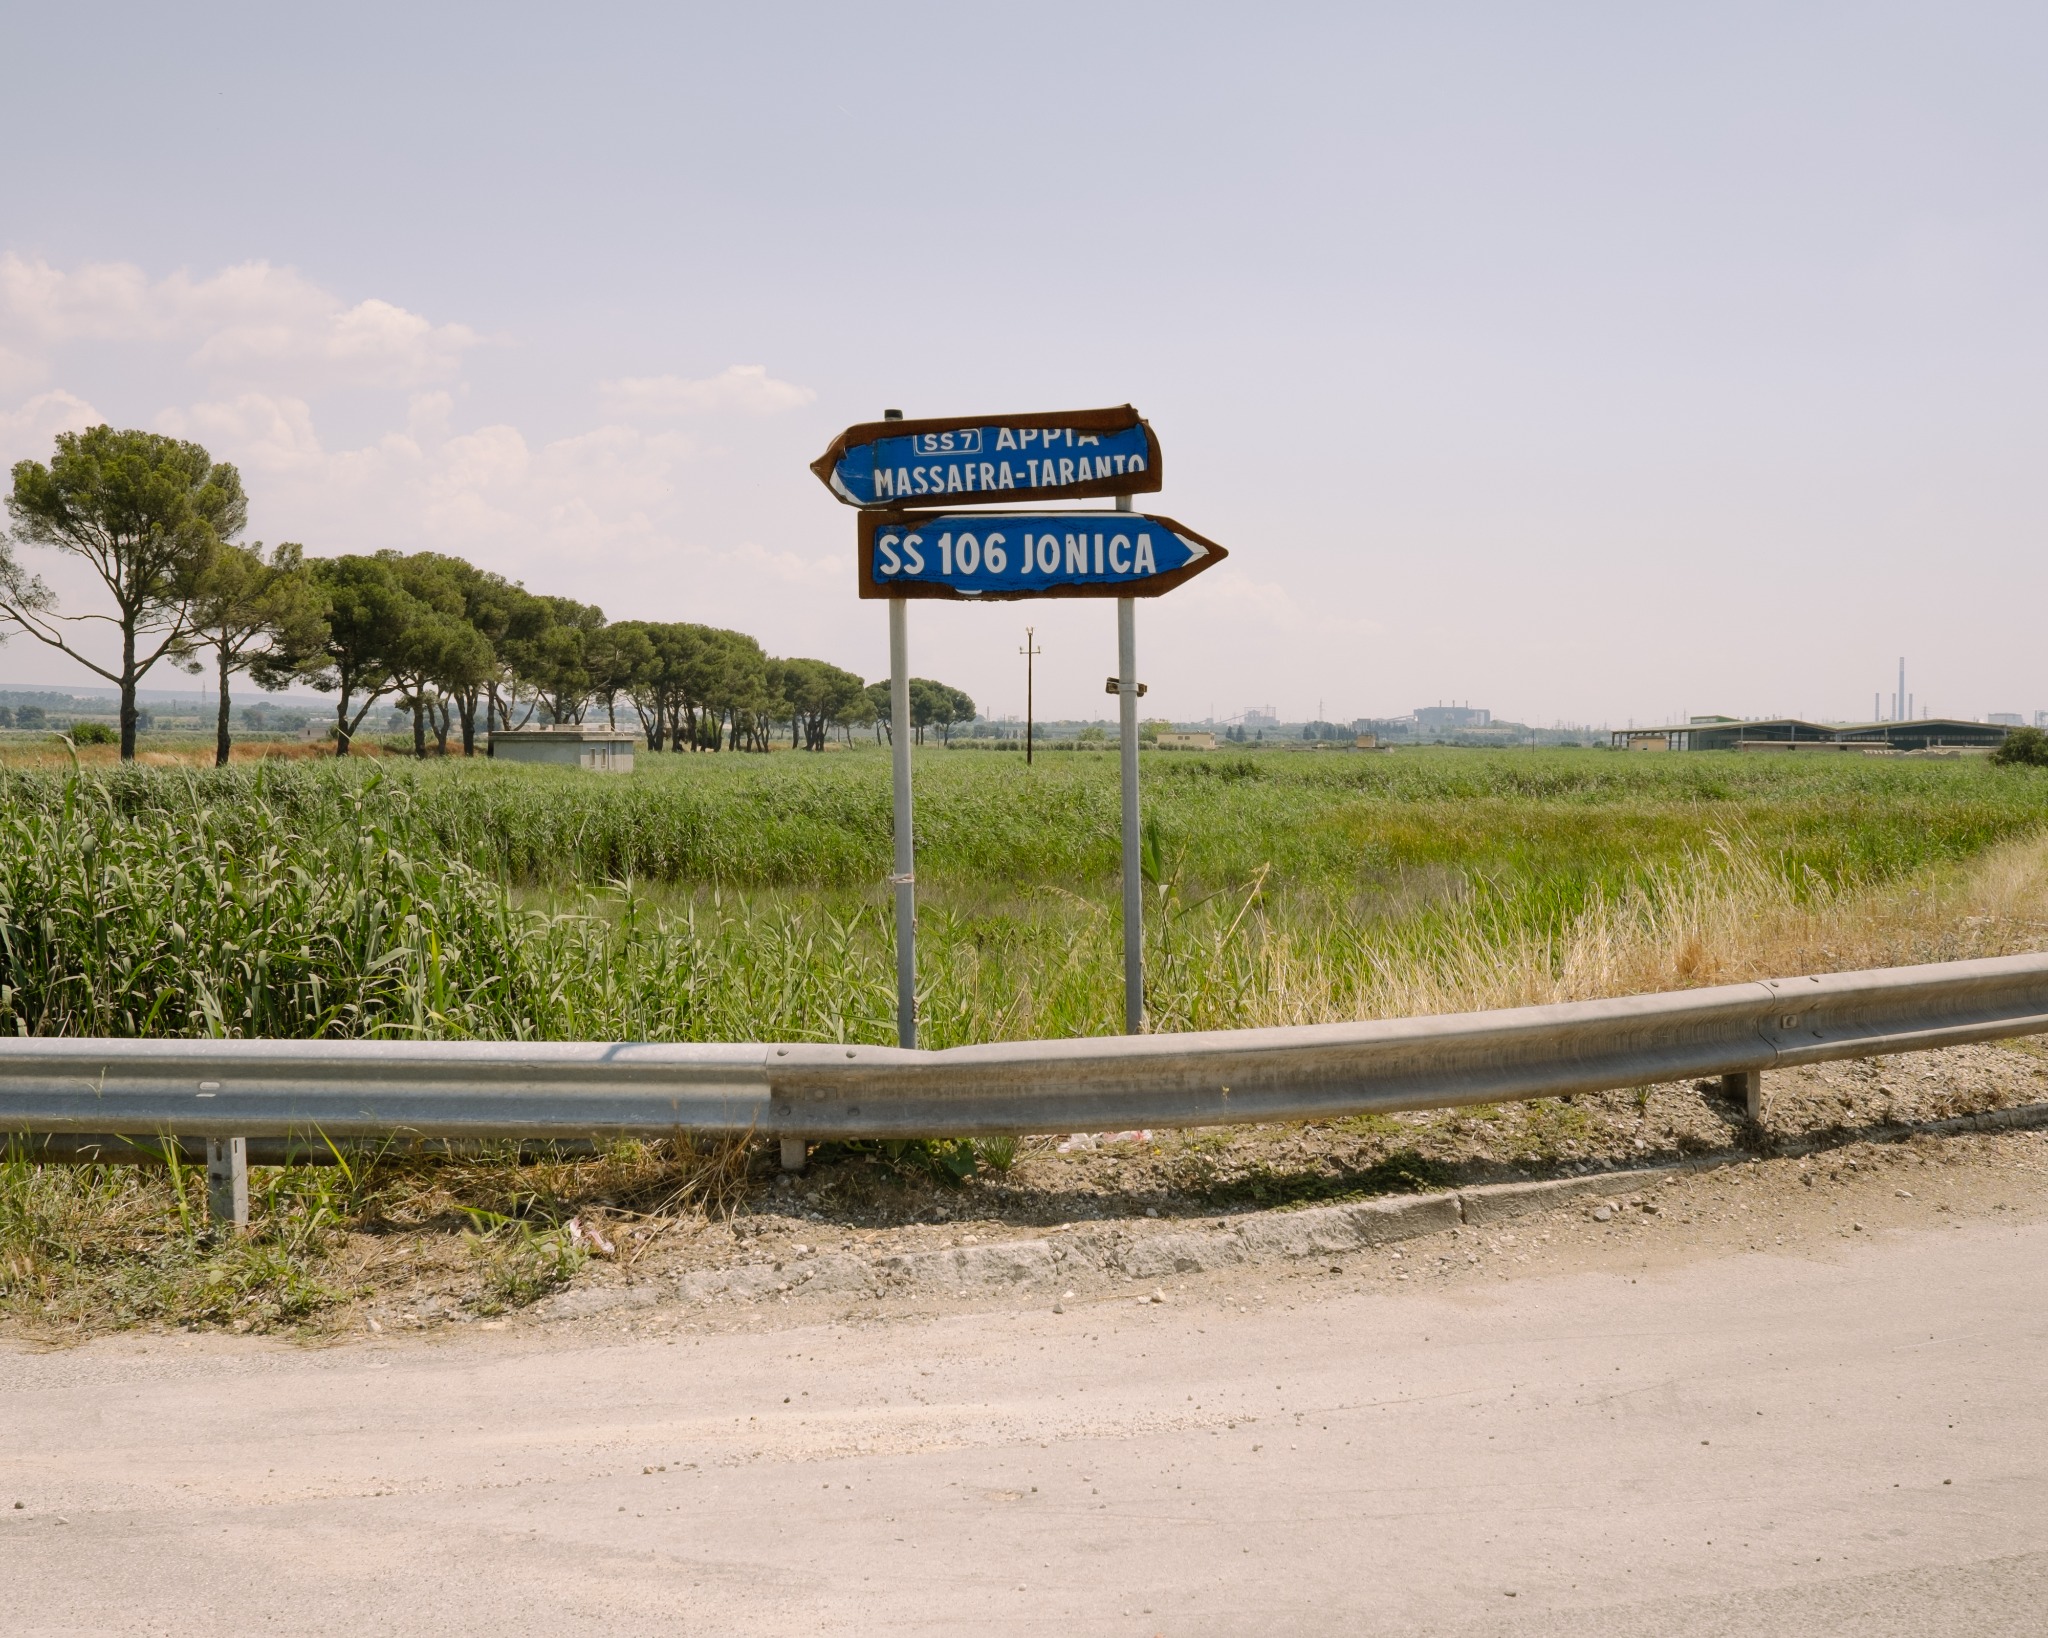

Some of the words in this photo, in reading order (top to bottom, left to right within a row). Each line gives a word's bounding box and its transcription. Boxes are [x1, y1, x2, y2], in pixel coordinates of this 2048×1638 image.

[924, 433, 954, 452] SS
[961, 432, 973, 450] 7
[995, 428, 1100, 452] APPIA
[874, 454, 1146, 498] MASSAFRA-TARANTO
[879, 534, 925, 575] SS
[937, 532, 1008, 575] 106
[1020, 533, 1157, 575] JONICA
